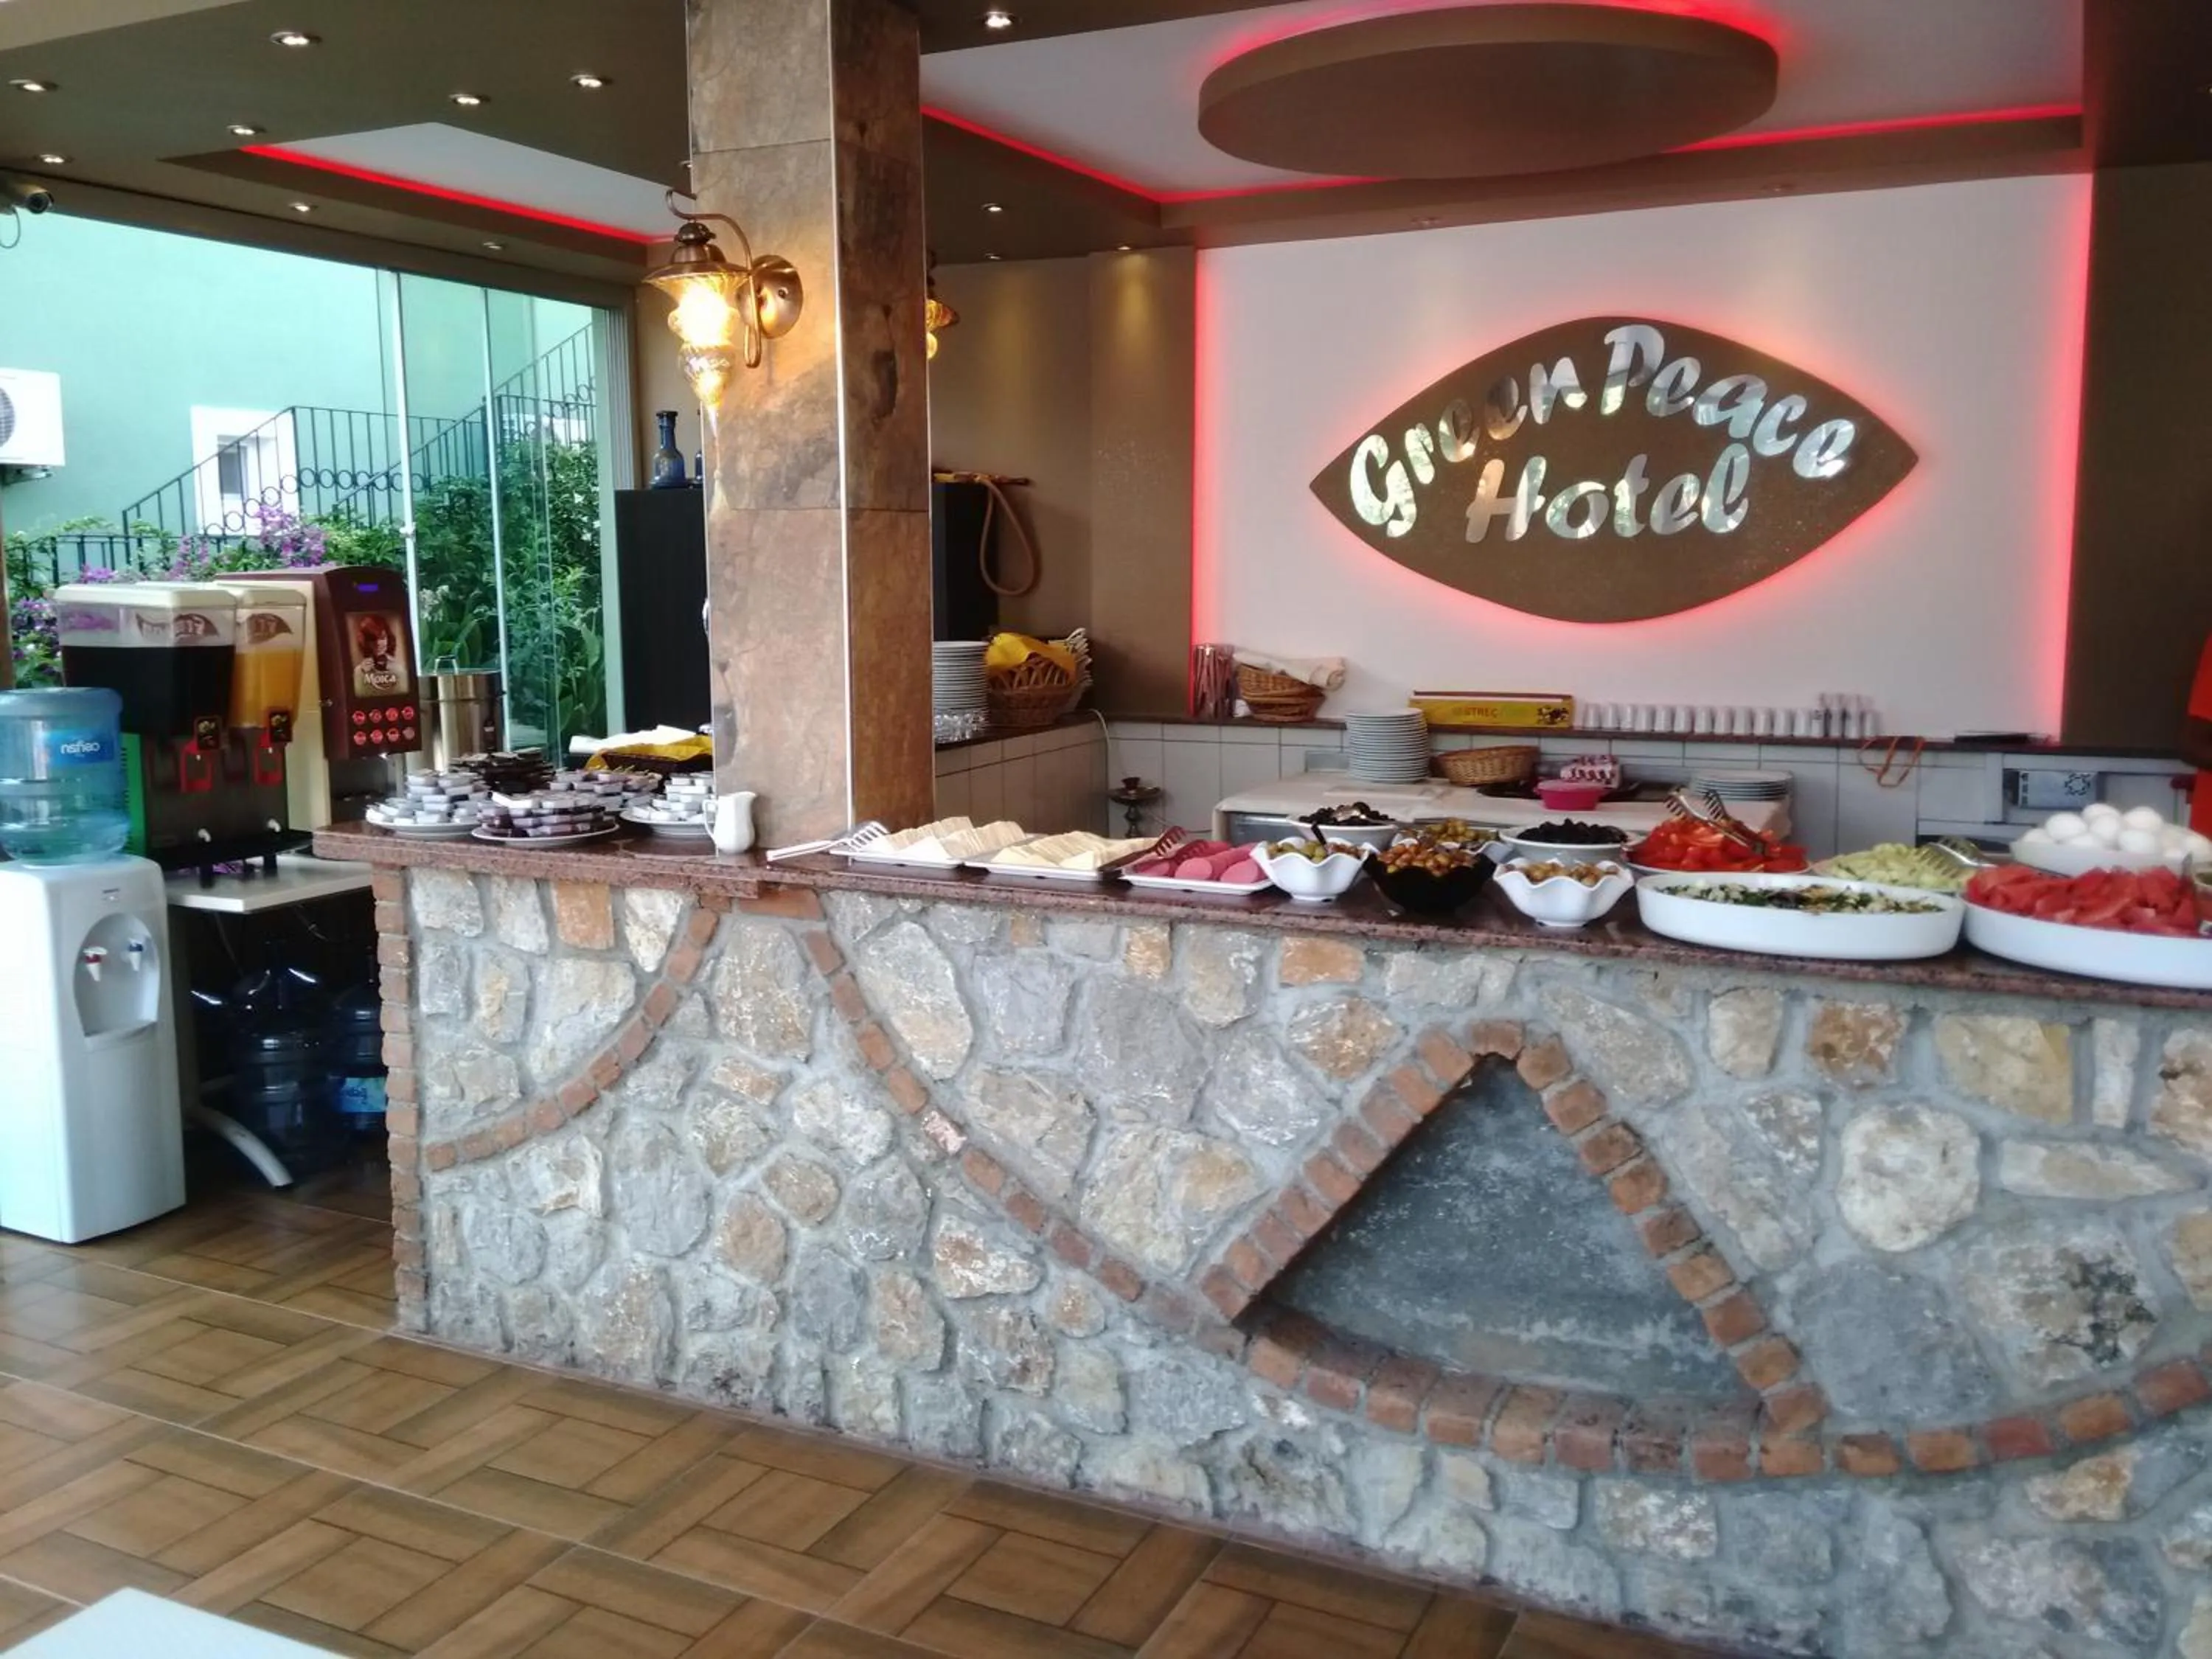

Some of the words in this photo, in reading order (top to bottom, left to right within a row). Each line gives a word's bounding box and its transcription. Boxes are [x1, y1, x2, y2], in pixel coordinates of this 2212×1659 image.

[1350, 358, 1587, 537] Green
[1601, 324, 1855, 478] Peace
[1466, 443, 1750, 543] Hotel
